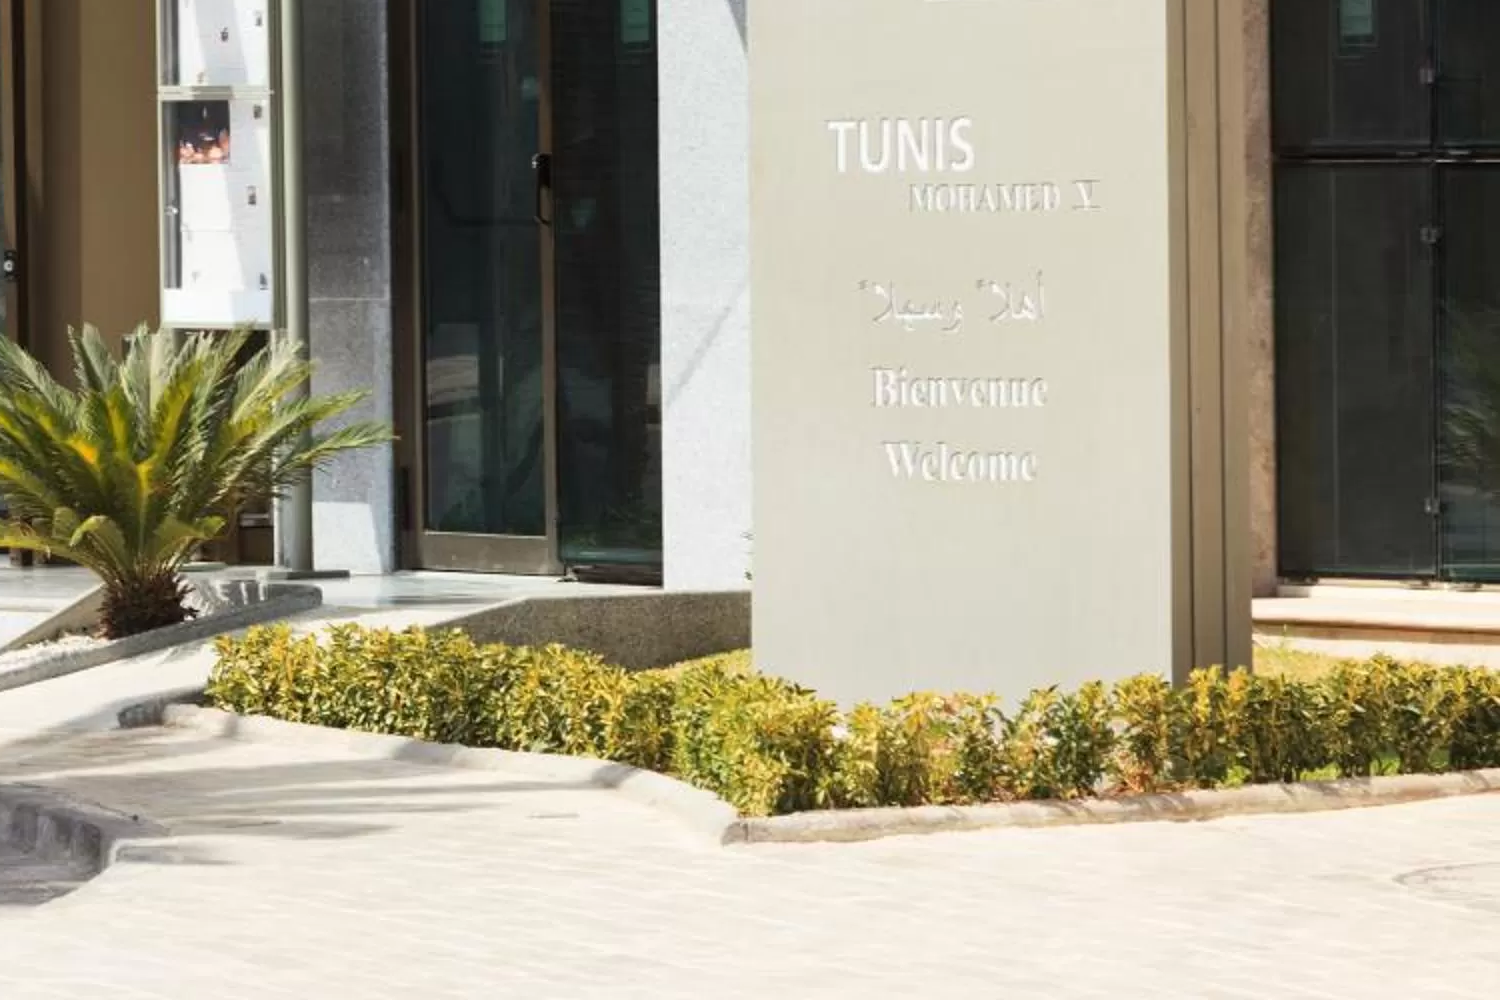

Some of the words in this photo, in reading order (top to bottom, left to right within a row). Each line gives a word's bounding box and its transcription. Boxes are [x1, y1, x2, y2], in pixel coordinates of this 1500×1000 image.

[826, 115, 976, 174] TUNIS
[909, 182, 1062, 213] MOHAMED
[869, 365, 1048, 408] Bienvenue
[881, 441, 1039, 482] Welcome
